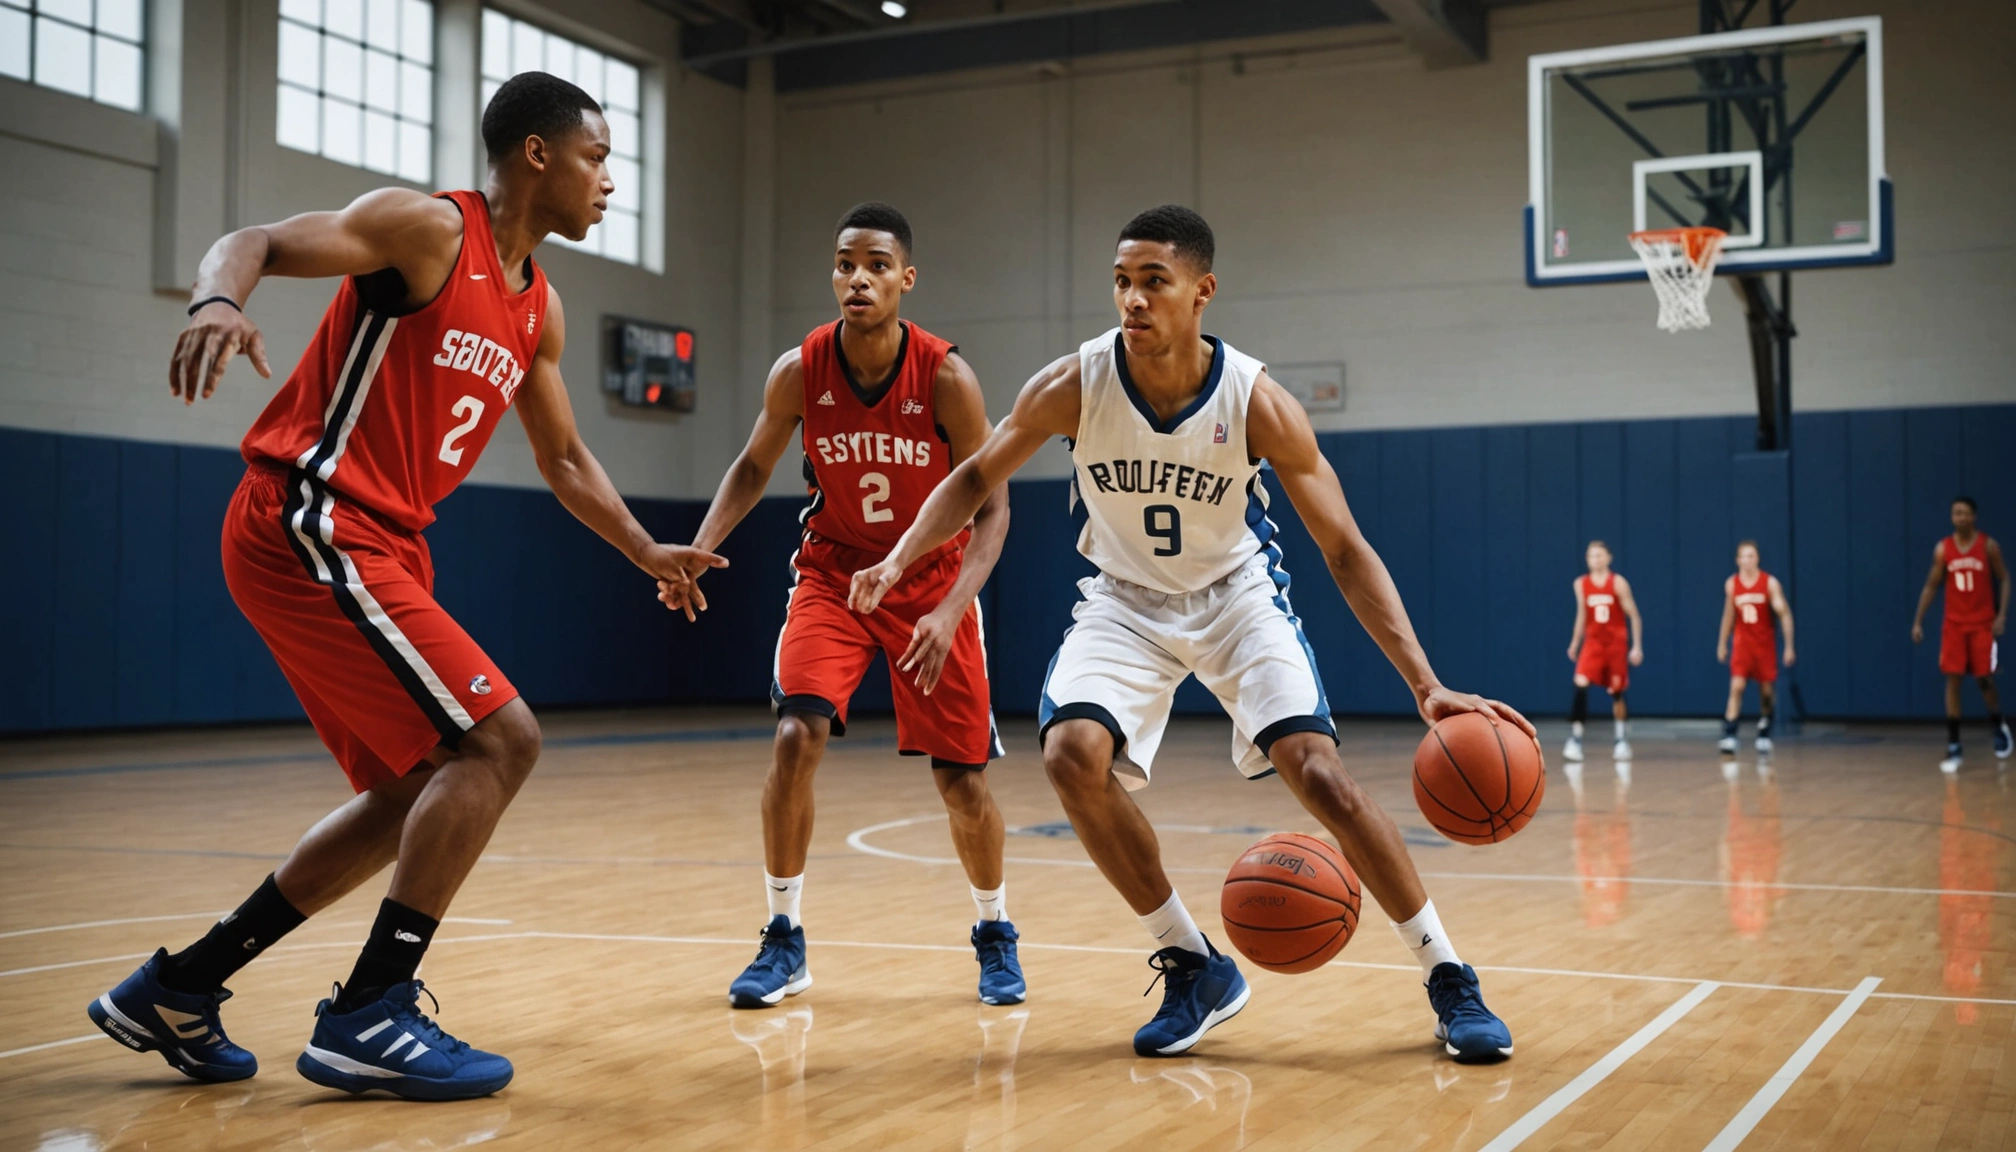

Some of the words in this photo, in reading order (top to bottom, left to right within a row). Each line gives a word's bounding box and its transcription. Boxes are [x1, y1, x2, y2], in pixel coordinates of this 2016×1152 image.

[438, 395, 485, 467] 2
[858, 471, 894, 523] 2
[1143, 504, 1182, 557] 9
